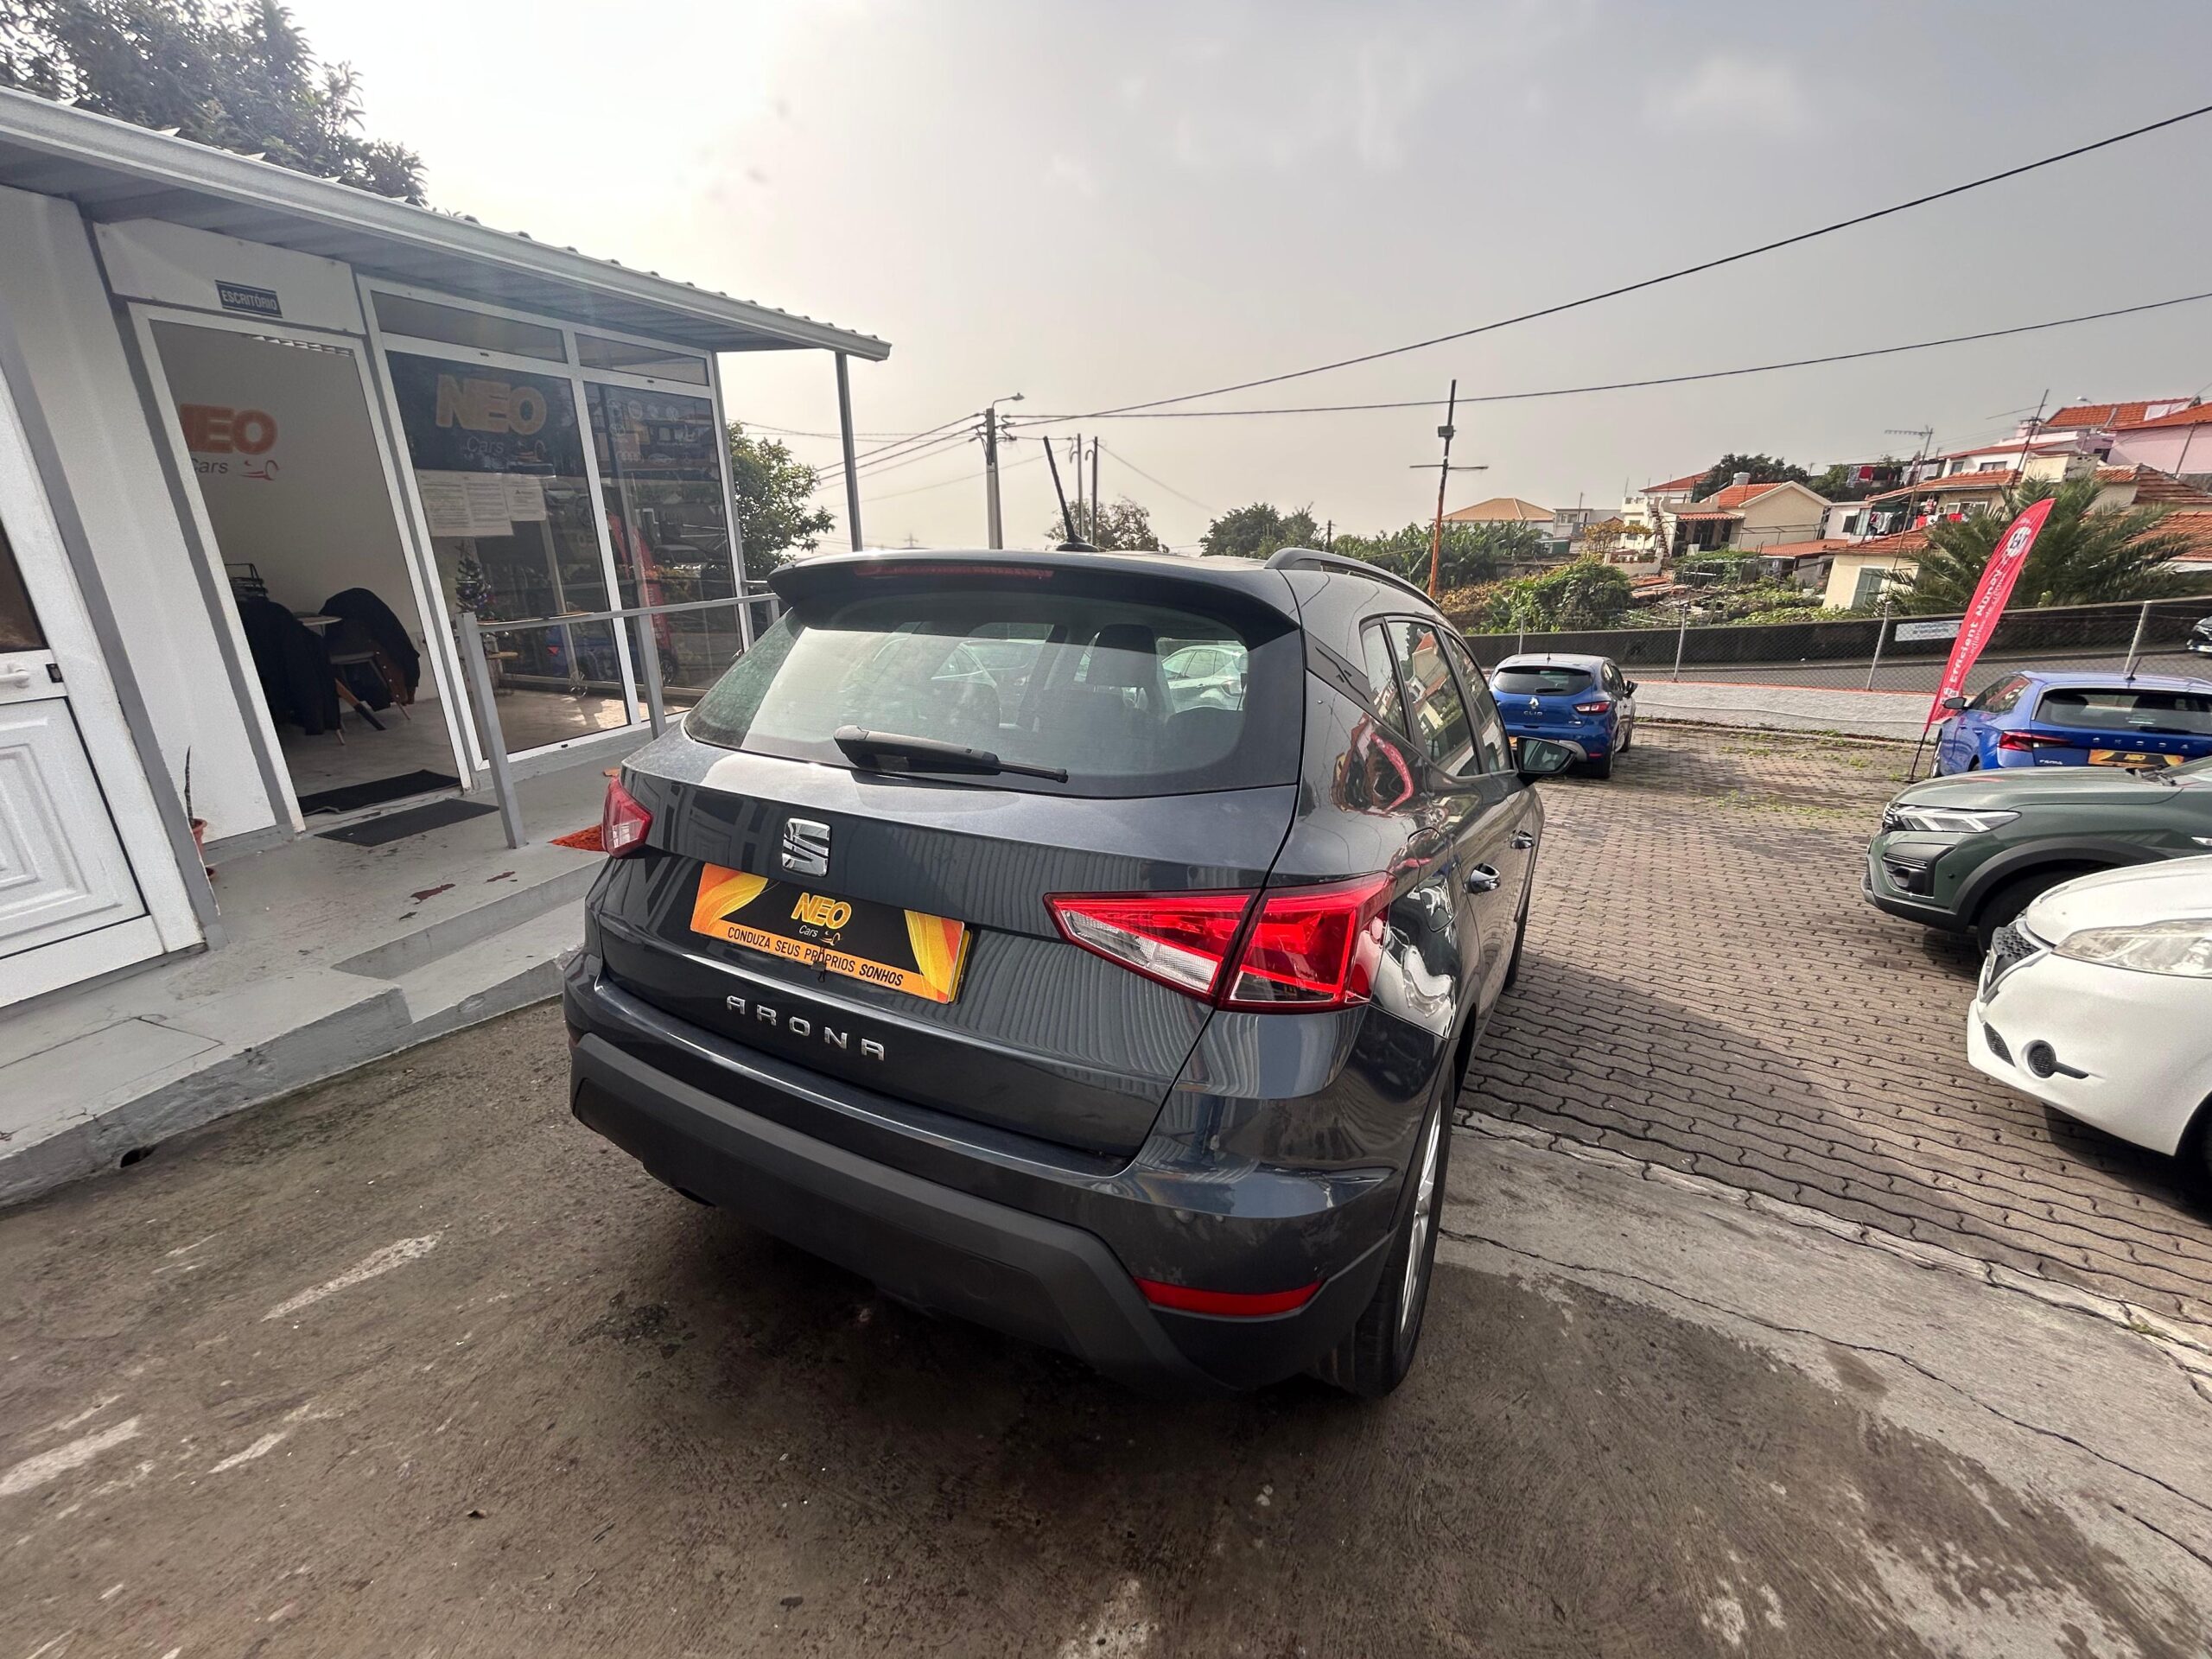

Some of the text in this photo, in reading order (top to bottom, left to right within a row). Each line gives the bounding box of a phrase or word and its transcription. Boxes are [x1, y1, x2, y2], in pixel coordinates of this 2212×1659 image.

[221, 289, 277, 311] ESCRITÓRIO
[435, 373, 547, 435] NEO
[467, 435, 505, 454] Cars
[791, 892, 852, 930] NEO
[798, 925, 819, 938] Cars
[728, 926, 771, 949] CONDUZA
[774, 939, 801, 957] SEUS
[859, 963, 904, 986] SONHOS
[726, 995, 885, 1062] ARONA
